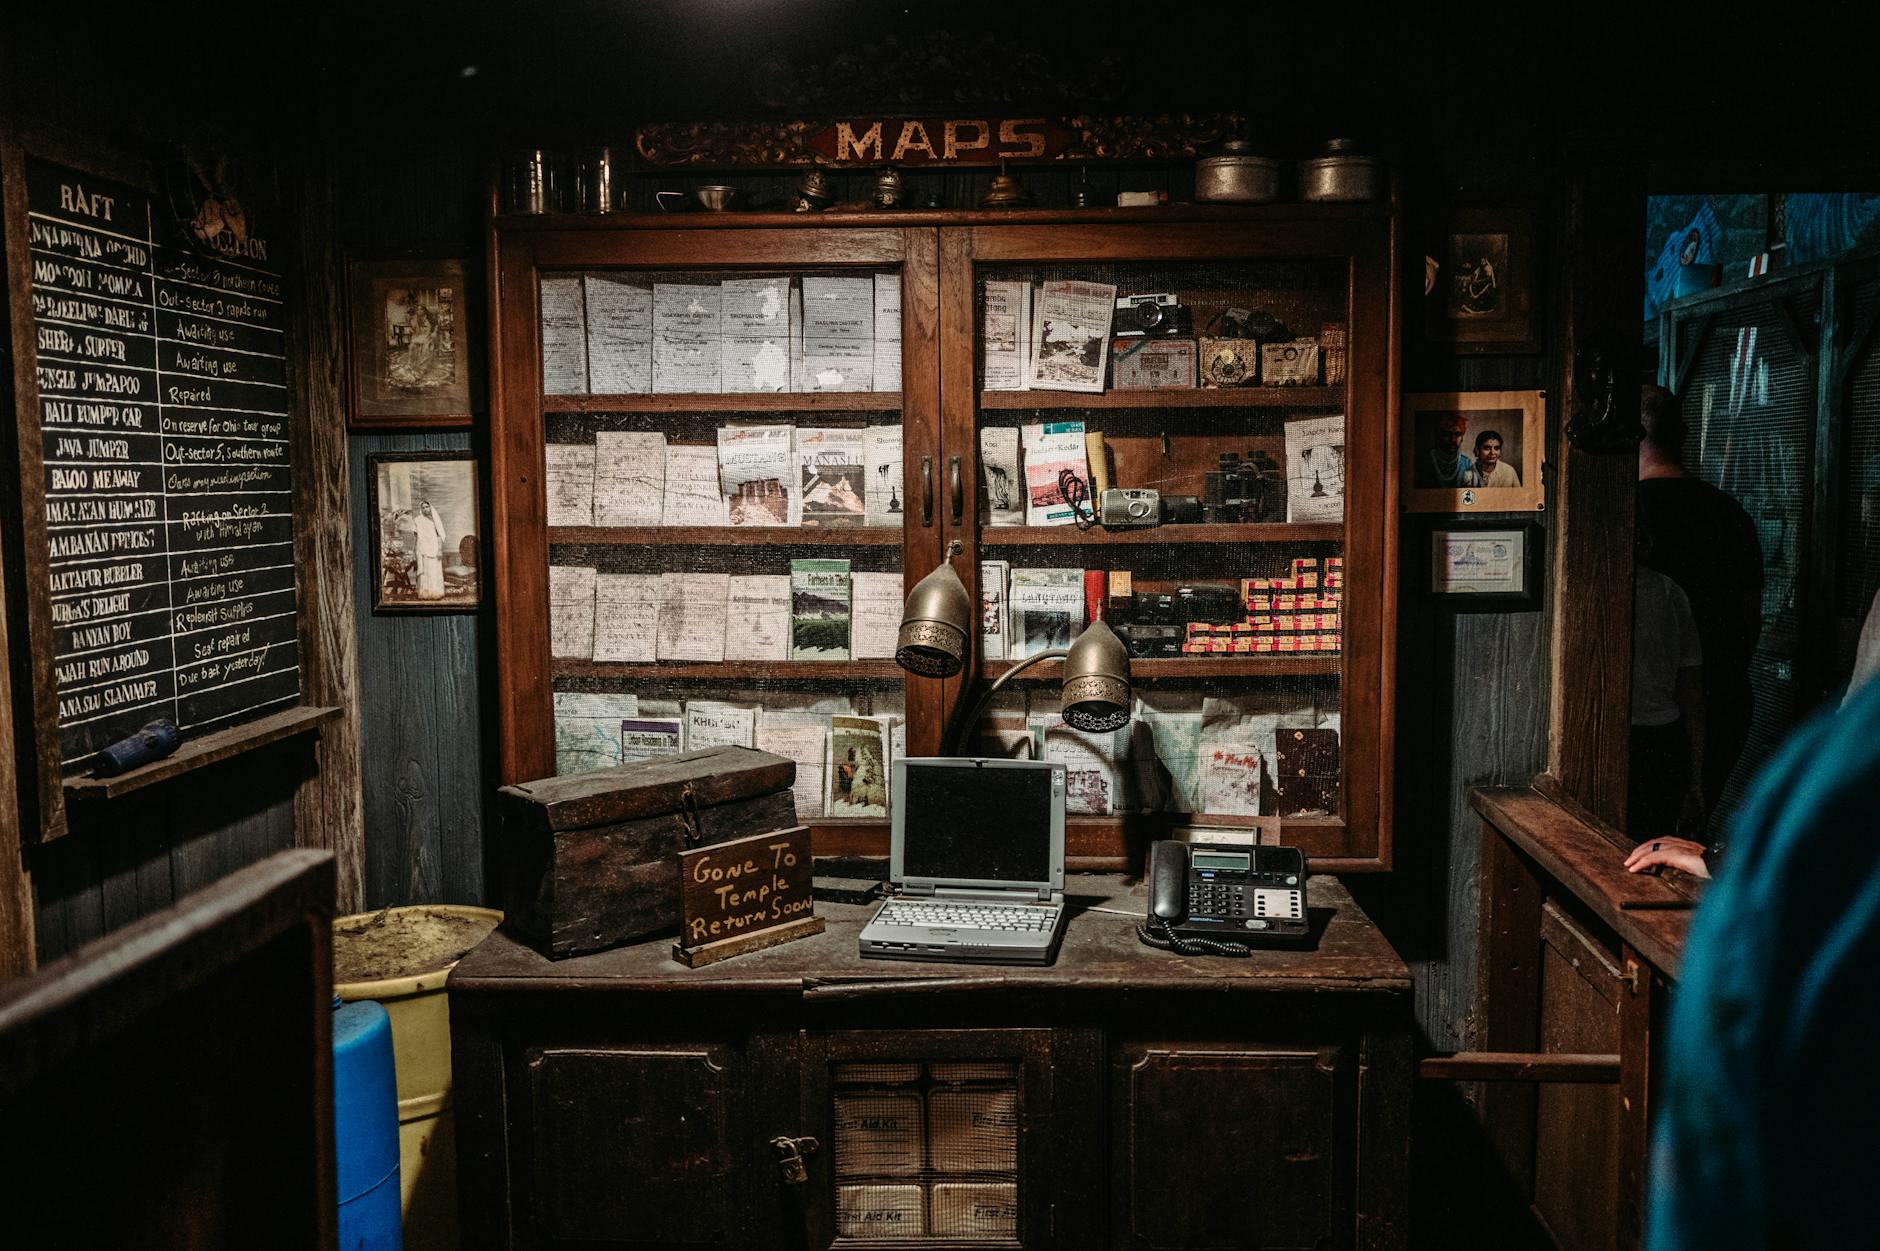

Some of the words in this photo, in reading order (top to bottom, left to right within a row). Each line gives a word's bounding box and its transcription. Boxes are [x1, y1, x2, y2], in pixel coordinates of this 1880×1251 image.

[836, 118, 1048, 161] MAPS
[61, 184, 114, 221] RAFT
[217, 300, 225, 316] 3
[177, 319, 218, 346] Awaiting
[219, 328, 236, 341] use
[176, 352, 219, 377] Awaiting
[222, 360, 238, 374] use
[168, 386, 212, 407] Repaired
[45, 402, 74, 423] BALI
[122, 407, 142, 428] CAR
[162, 418, 178, 431] On
[179, 420, 208, 434] reserve
[208, 418, 222, 435] for
[243, 419, 260, 433] tour
[260, 423, 282, 439] group
[56, 438, 84, 459] JAVA
[87, 438, 129, 460] JUMPER
[263, 443, 284, 460] route
[261, 502, 271, 515] 2
[220, 554, 235, 568] use
[186, 582, 226, 604] Awaiting
[228, 578, 244, 593] use
[92, 593, 130, 617] DELIGHT
[73, 625, 110, 650] BANYAN
[112, 620, 132, 642] BOY
[194, 637, 216, 659] Seat
[217, 627, 250, 652] repaired
[55, 661, 86, 687] AJAH
[89, 656, 111, 679] RUN
[179, 672, 199, 687] Due
[202, 664, 220, 680] back
[59, 695, 101, 720] ANASLU
[104, 680, 158, 710] SLAMMER
[694, 856, 759, 883] Gone
[768, 842, 797, 869] To
[714, 874, 790, 911] Temple
[690, 911, 767, 941] Return
[771, 895, 814, 920] Soon
